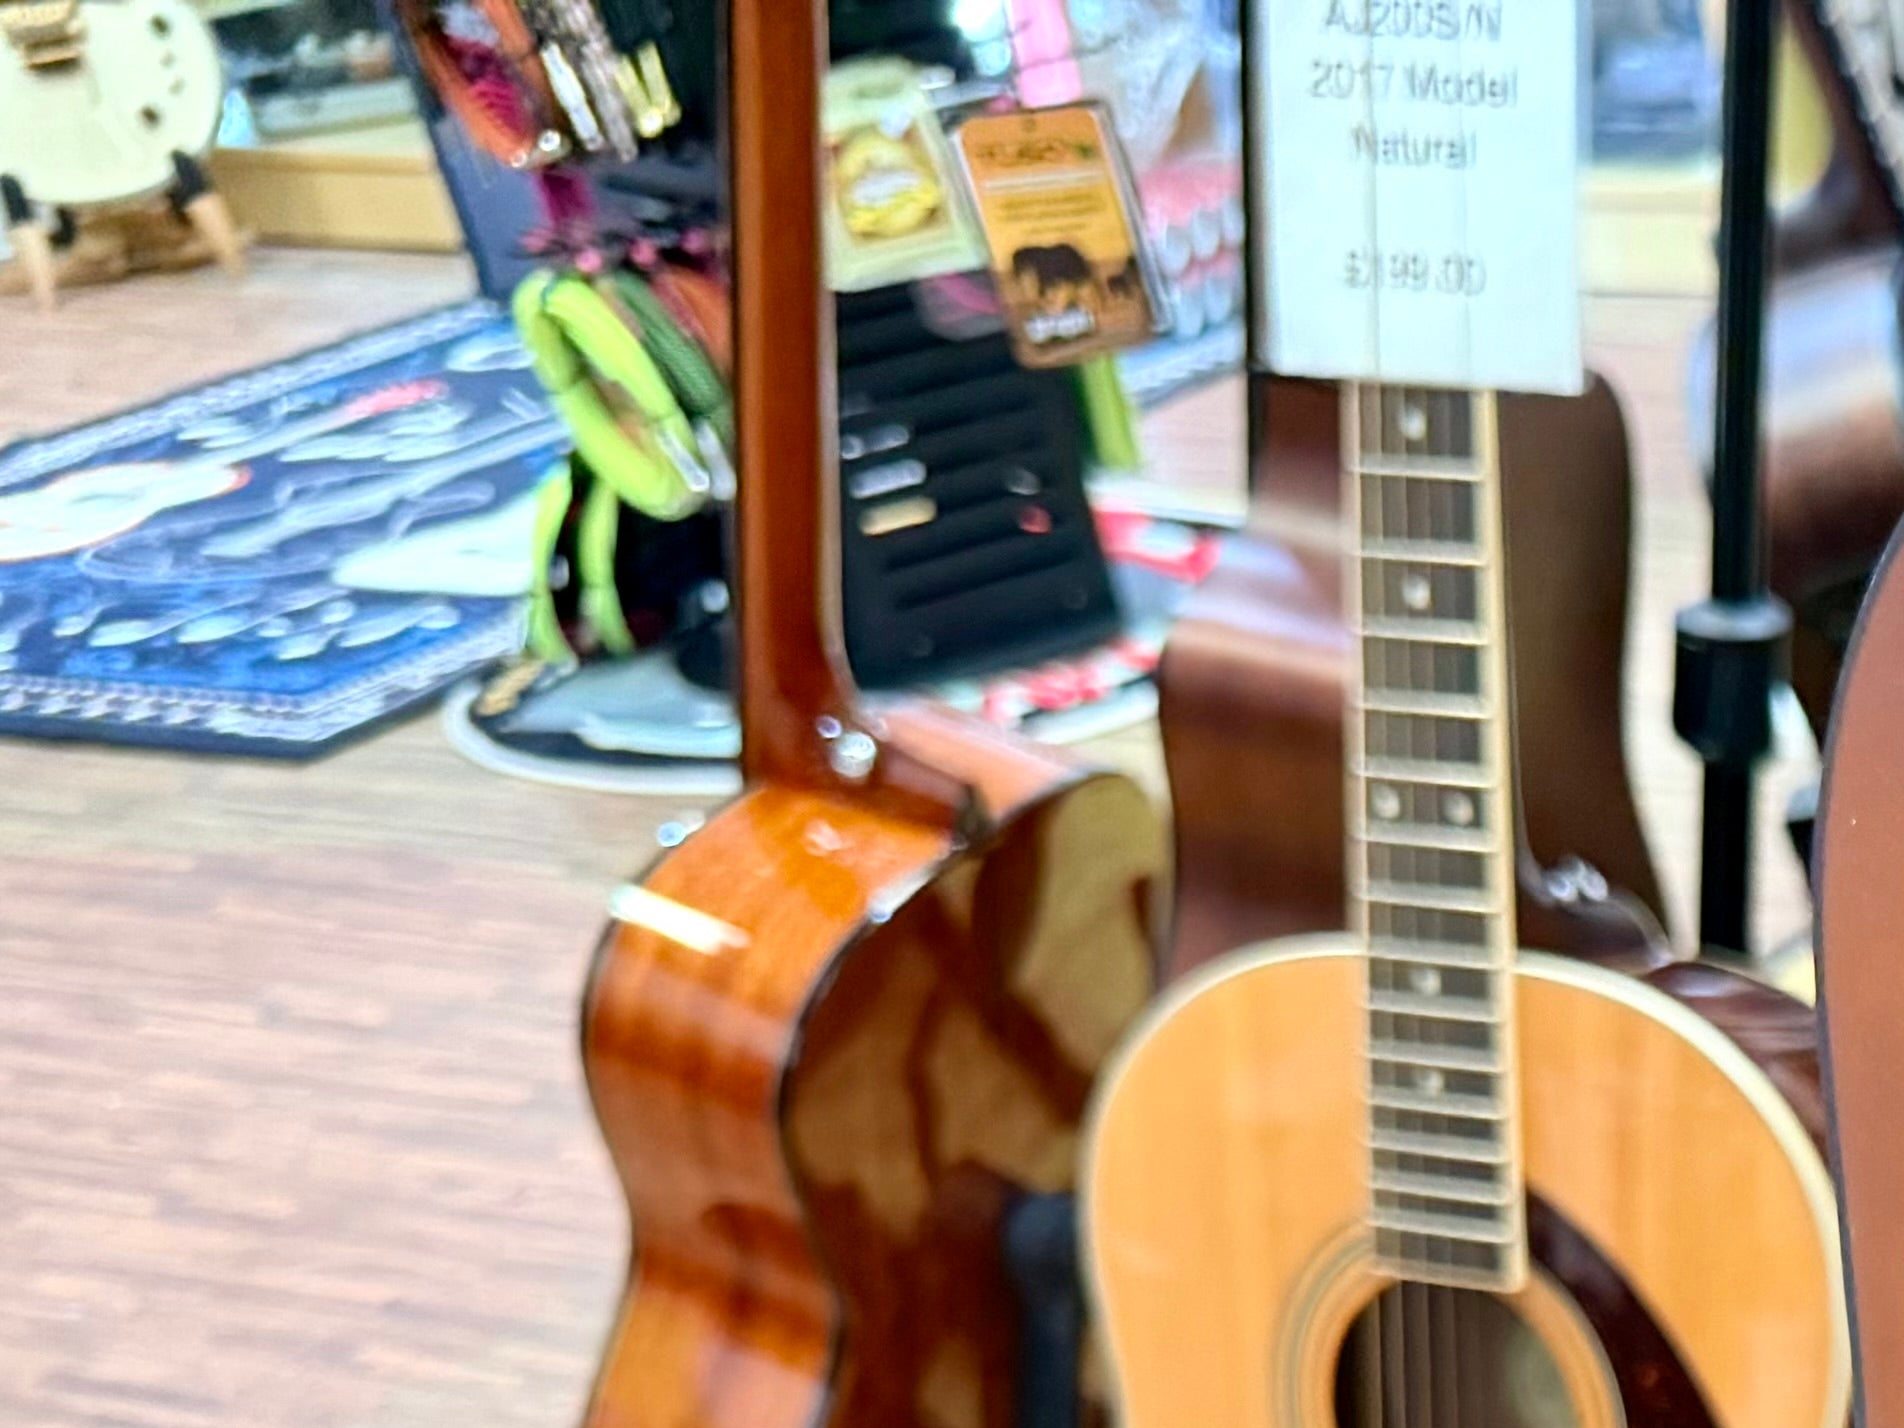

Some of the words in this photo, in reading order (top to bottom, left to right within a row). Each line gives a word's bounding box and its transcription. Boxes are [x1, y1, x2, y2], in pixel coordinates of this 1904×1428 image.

[1308, 58, 1394, 100] 2017
[1405, 62, 1519, 108] Model
[1349, 123, 1477, 170] Natural
